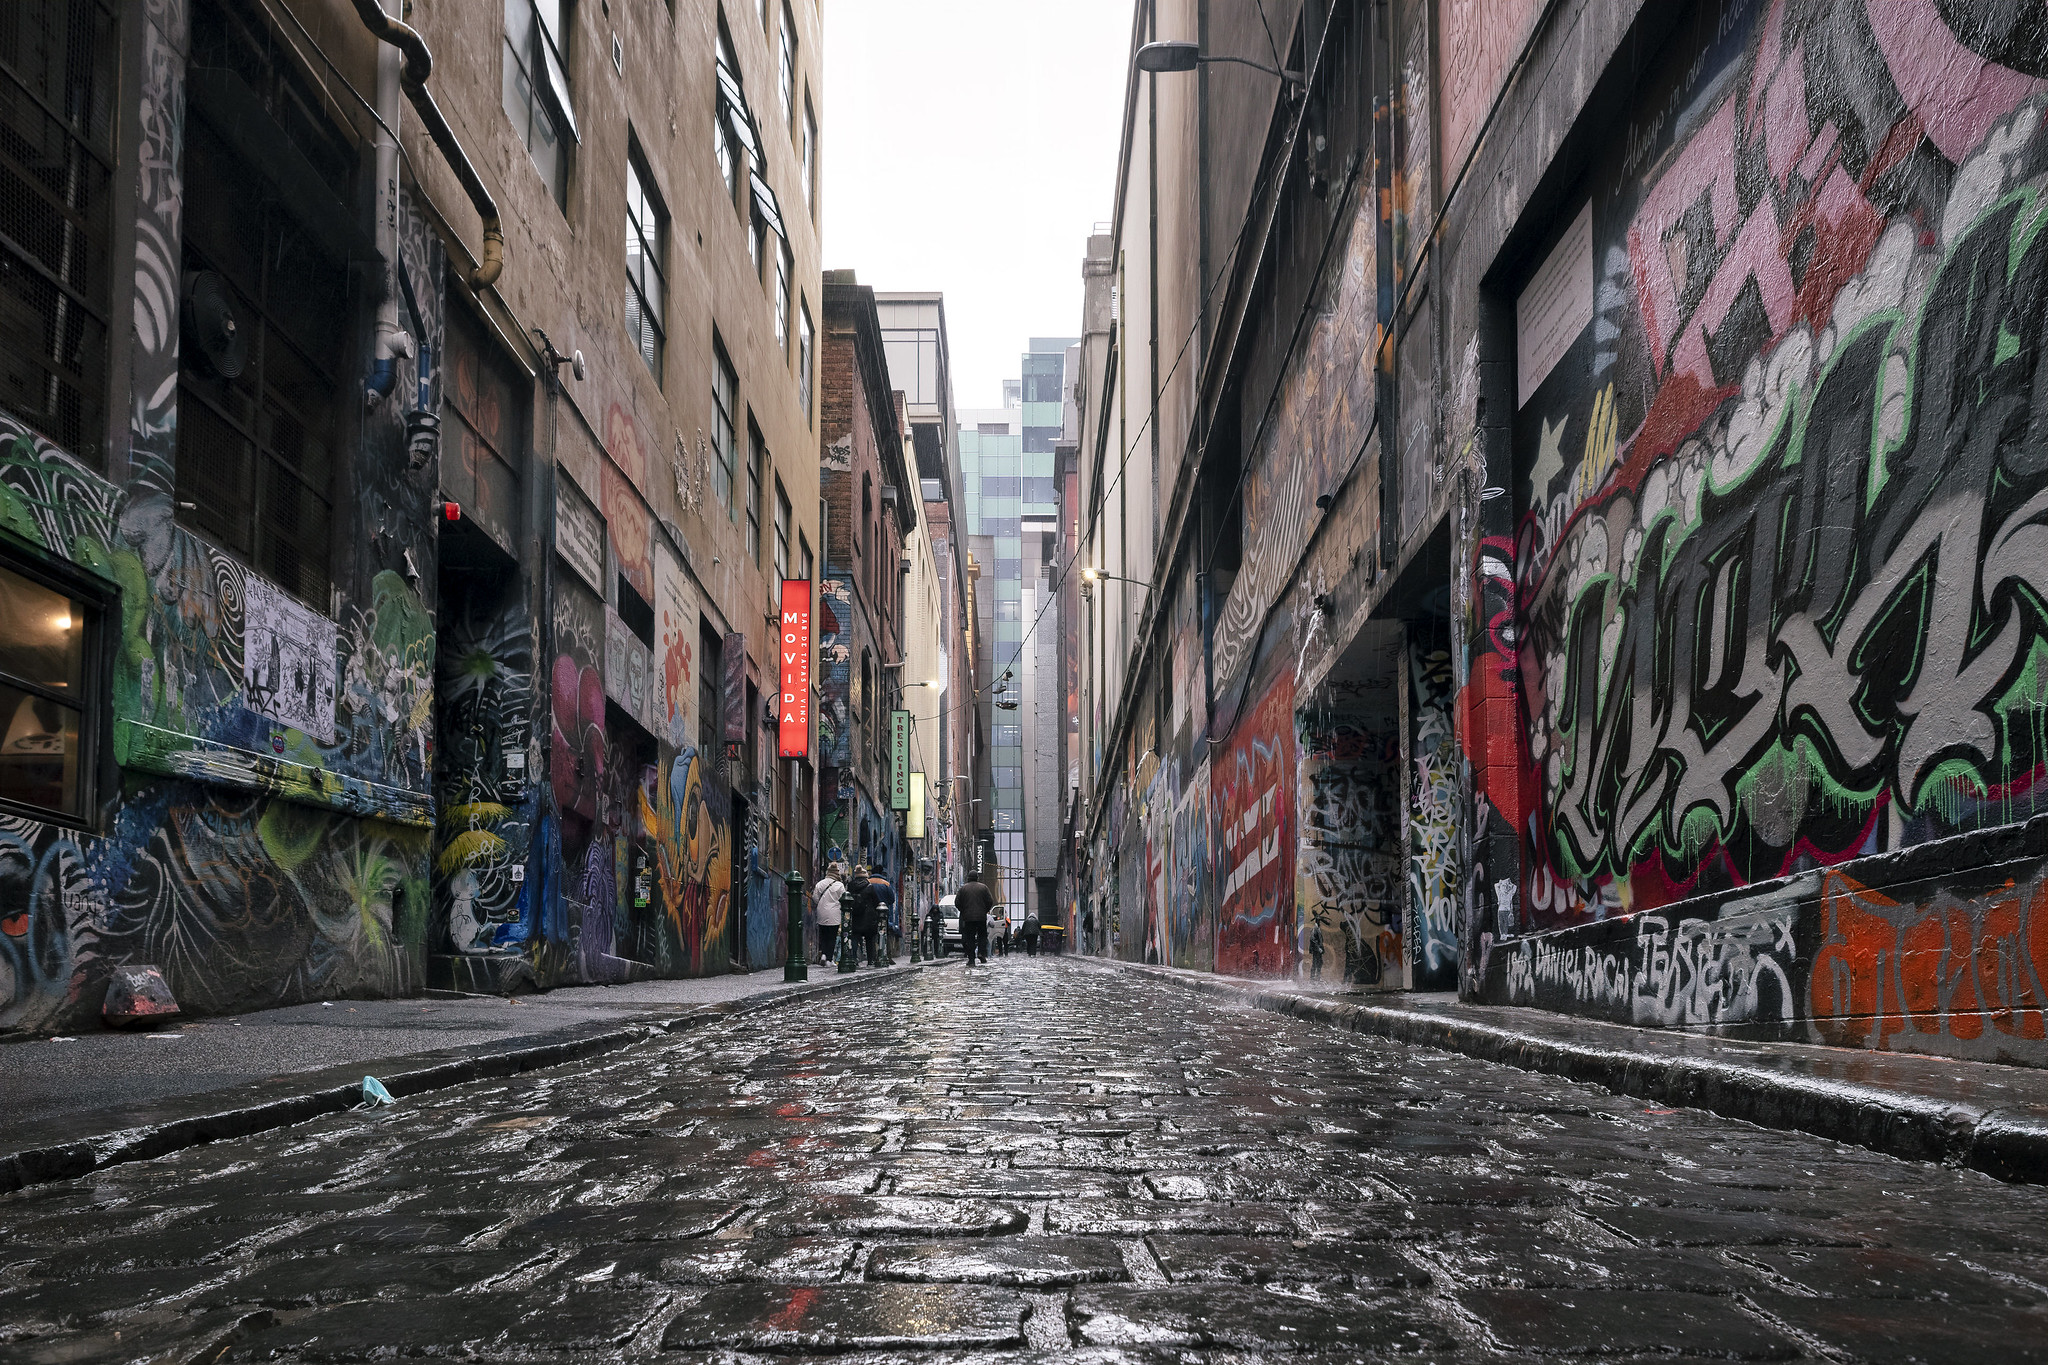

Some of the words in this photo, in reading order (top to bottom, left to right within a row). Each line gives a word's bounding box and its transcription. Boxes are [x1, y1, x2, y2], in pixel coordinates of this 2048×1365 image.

[1615, 110, 1665, 196] Always
[1669, 85, 1680, 114] in
[1686, 44, 1710, 92] our
[801, 636, 808, 648] DE
[784, 612, 798, 723] MOVIDA
[896, 716, 904, 748] TRES
[896, 754, 904, 795] CINCO
